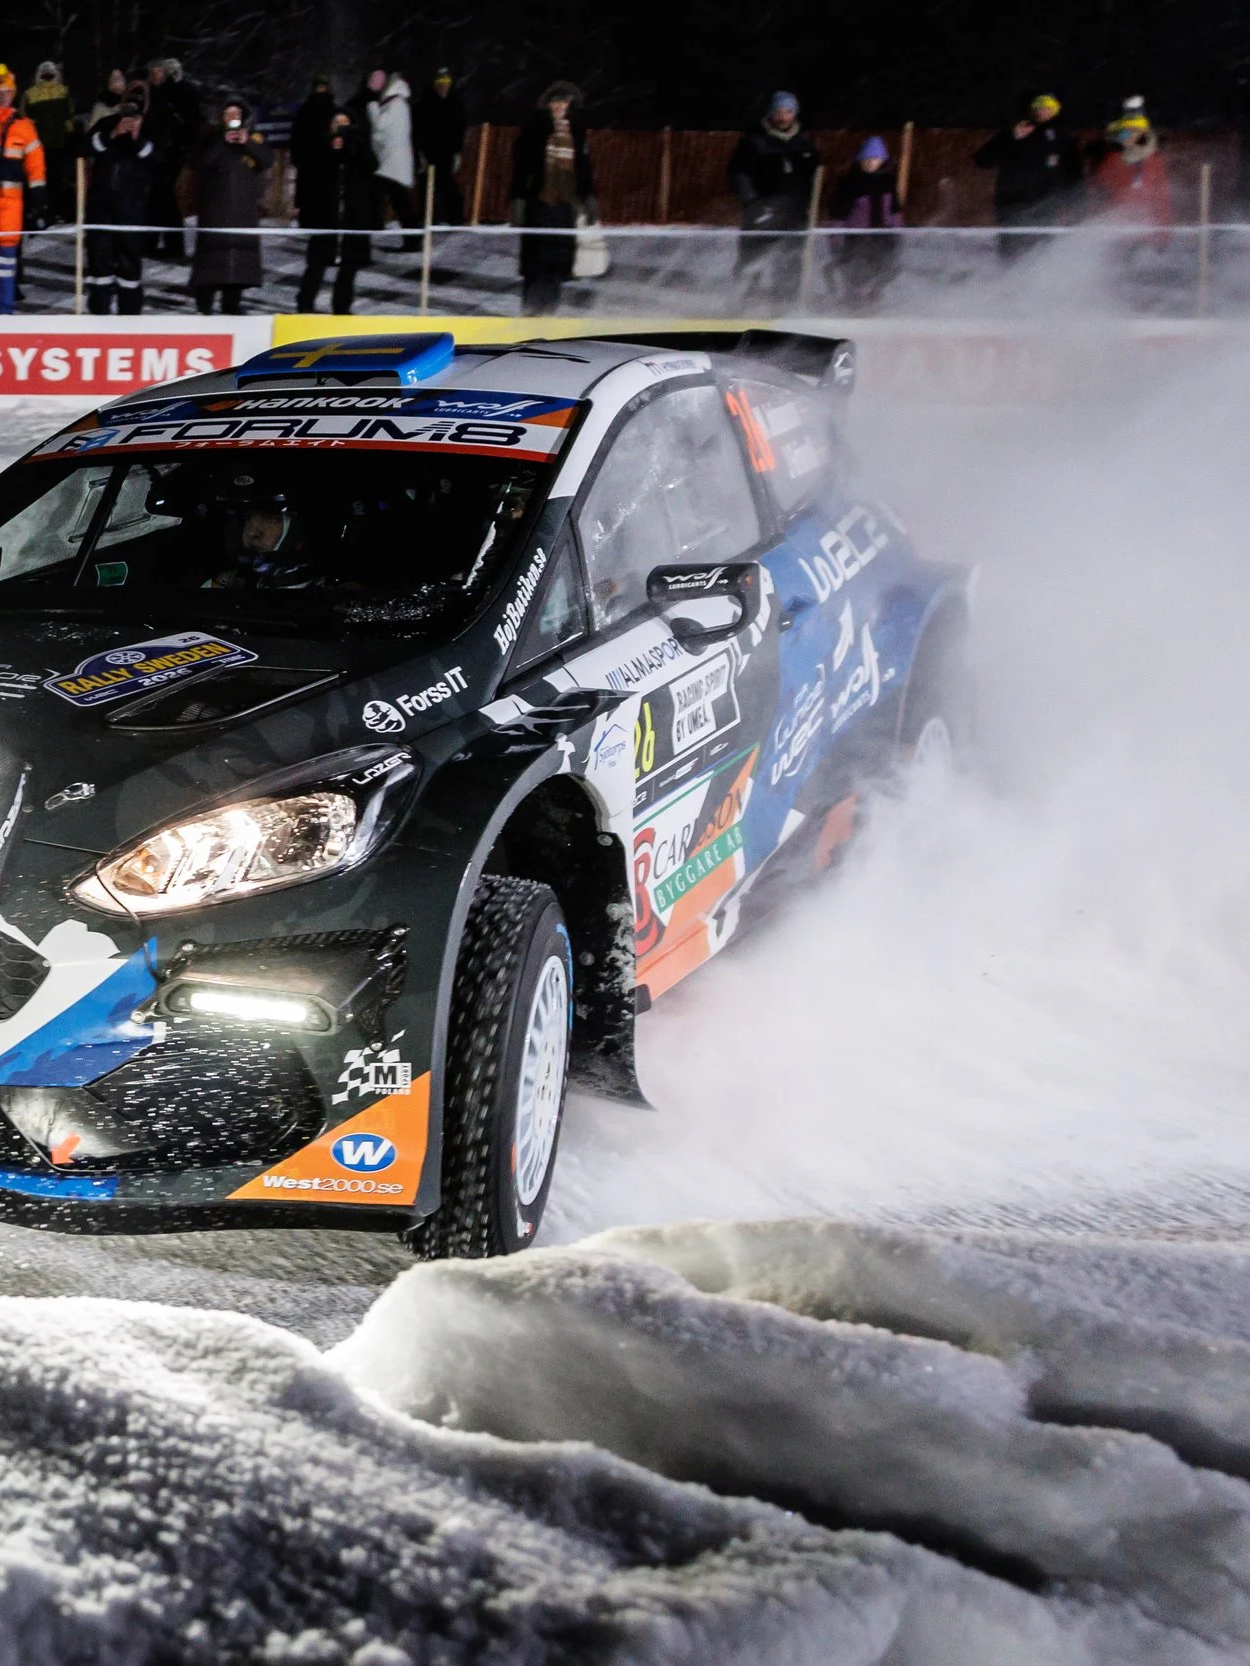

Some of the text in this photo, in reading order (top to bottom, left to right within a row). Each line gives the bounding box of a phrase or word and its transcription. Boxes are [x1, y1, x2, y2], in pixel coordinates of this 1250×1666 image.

[118, 418, 527, 446] FORUM8
[57, 642, 232, 695] RALLY SWEDEN
[618, 637, 684, 688] ALMASPOR
[137, 667, 194, 687] 2026
[656, 826, 743, 908] BYGGARE AB
[374, 1065, 397, 1085] M
[374, 1088, 411, 1096] POLAND
[341, 1140, 394, 1166] W
[262, 1175, 404, 1195] West2000.se
